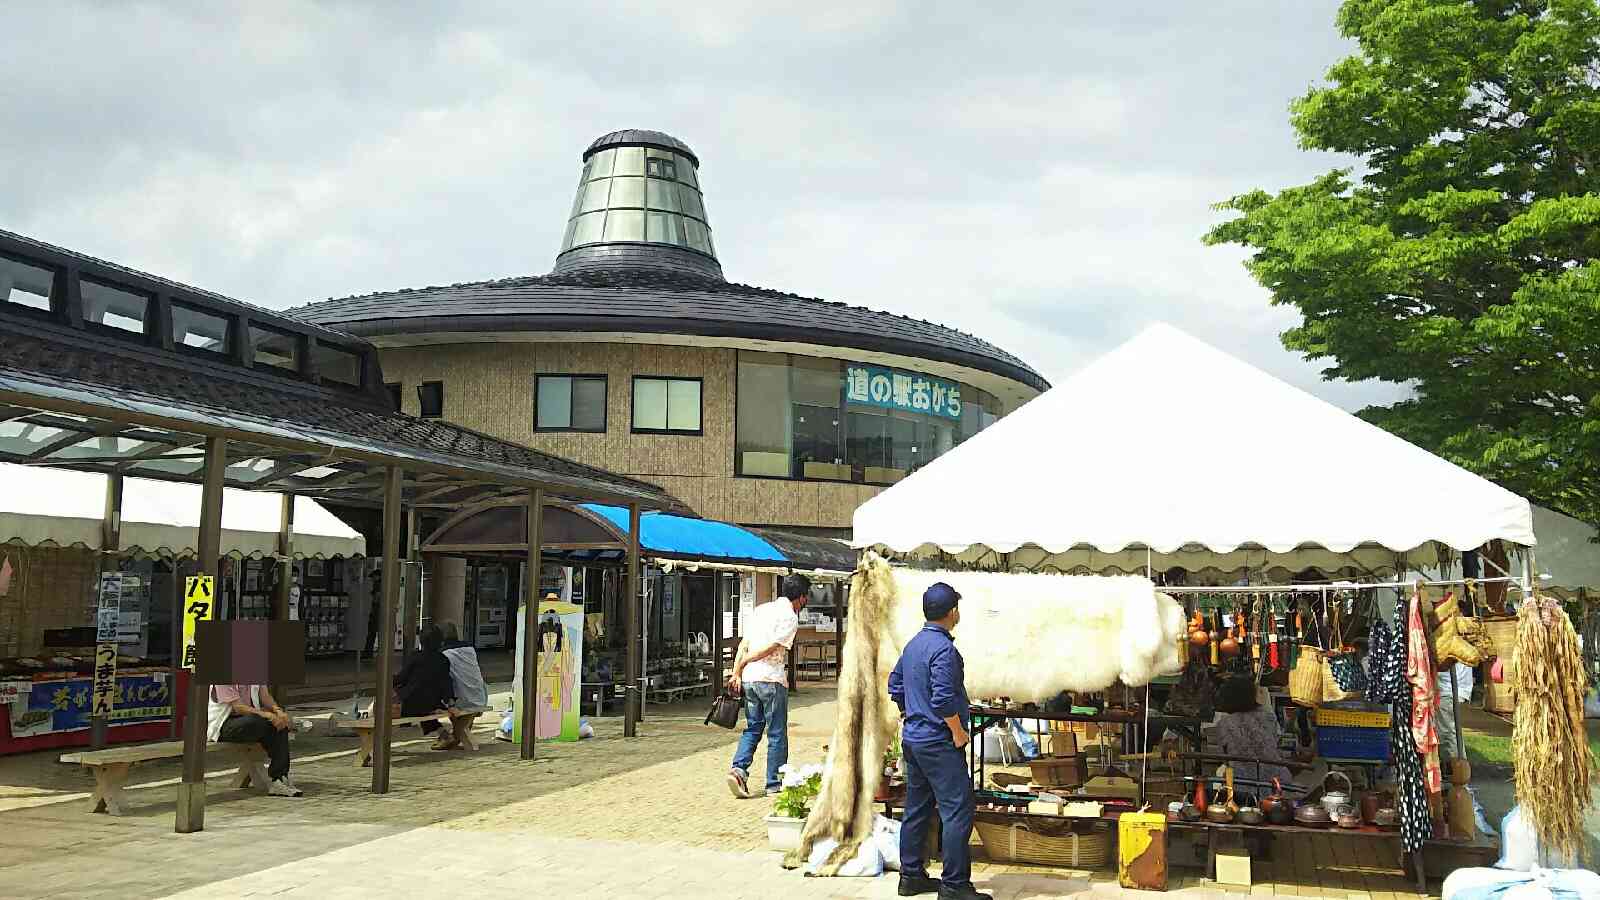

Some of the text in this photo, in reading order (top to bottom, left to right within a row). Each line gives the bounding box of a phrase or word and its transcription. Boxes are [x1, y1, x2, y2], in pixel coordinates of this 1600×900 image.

[847, 367, 961, 416] 道の駅おがち
